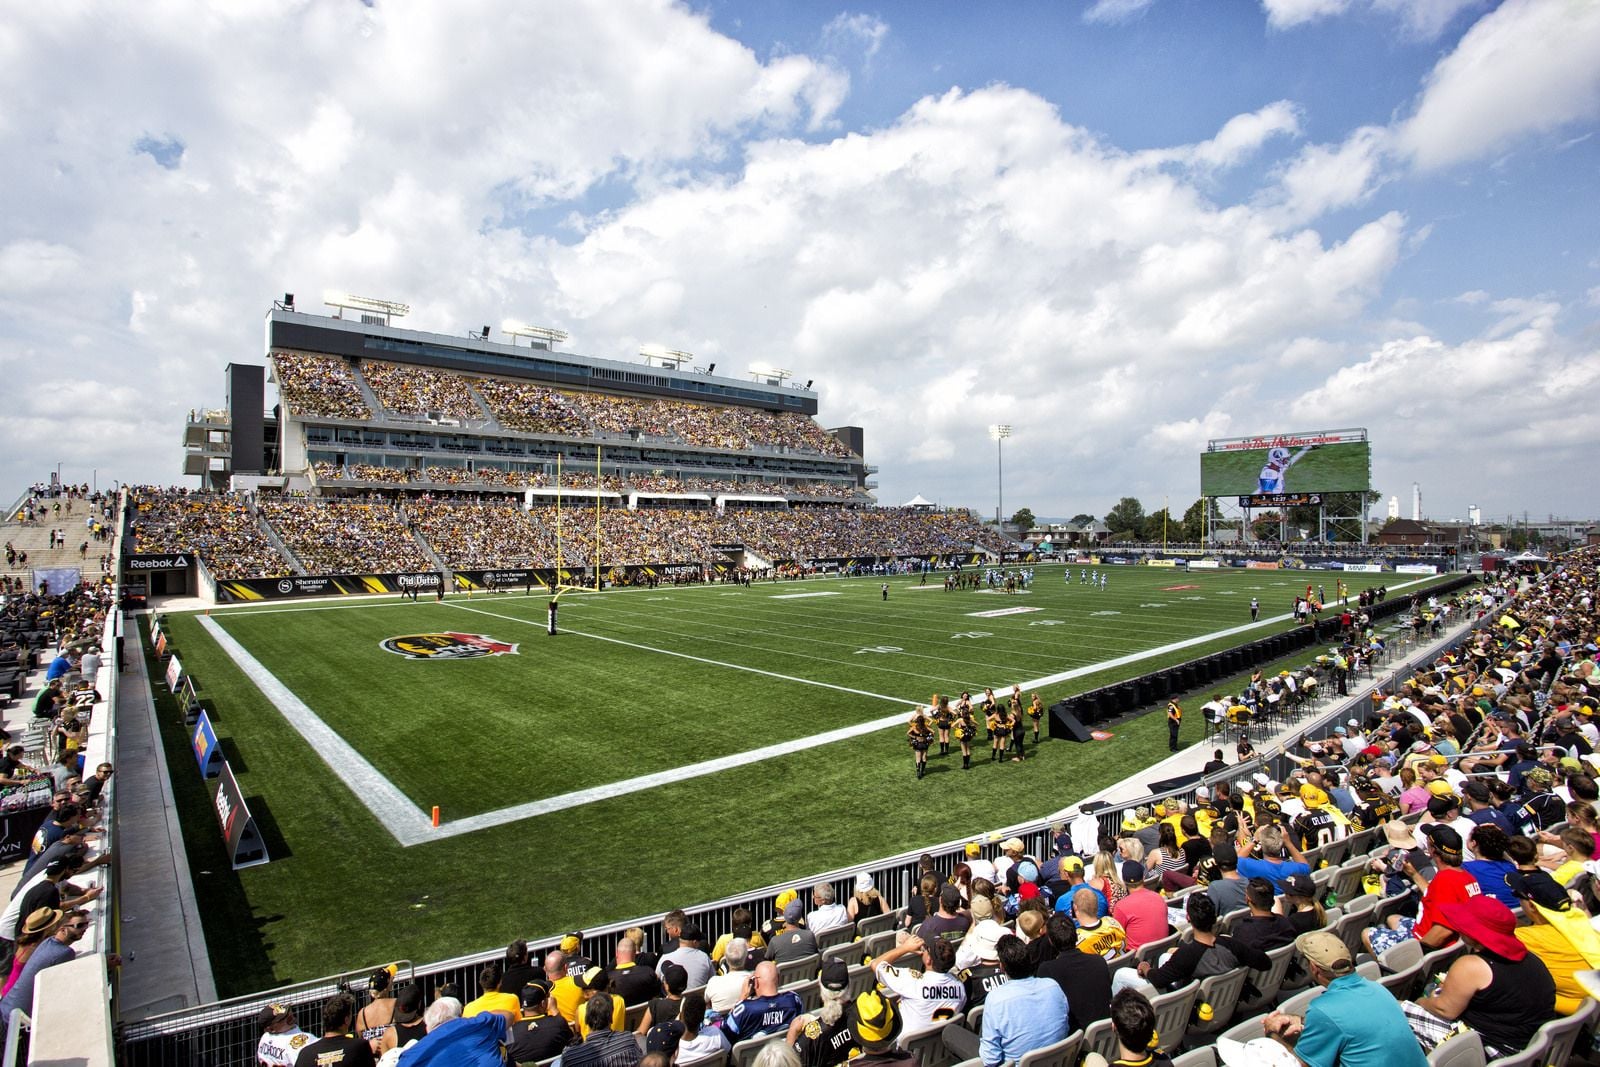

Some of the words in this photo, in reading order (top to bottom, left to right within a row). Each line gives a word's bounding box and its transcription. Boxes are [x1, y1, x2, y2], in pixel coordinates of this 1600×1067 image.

[130, 559, 173, 569] Reebok
[400, 576, 414, 584] Old
[415, 575, 439, 587] Dutch
[76, 694, 95, 707] 22
[566, 964, 586, 977] RUCE
[922, 986, 960, 1000] CONSOLI
[762, 1010, 784, 1026] AVERY
